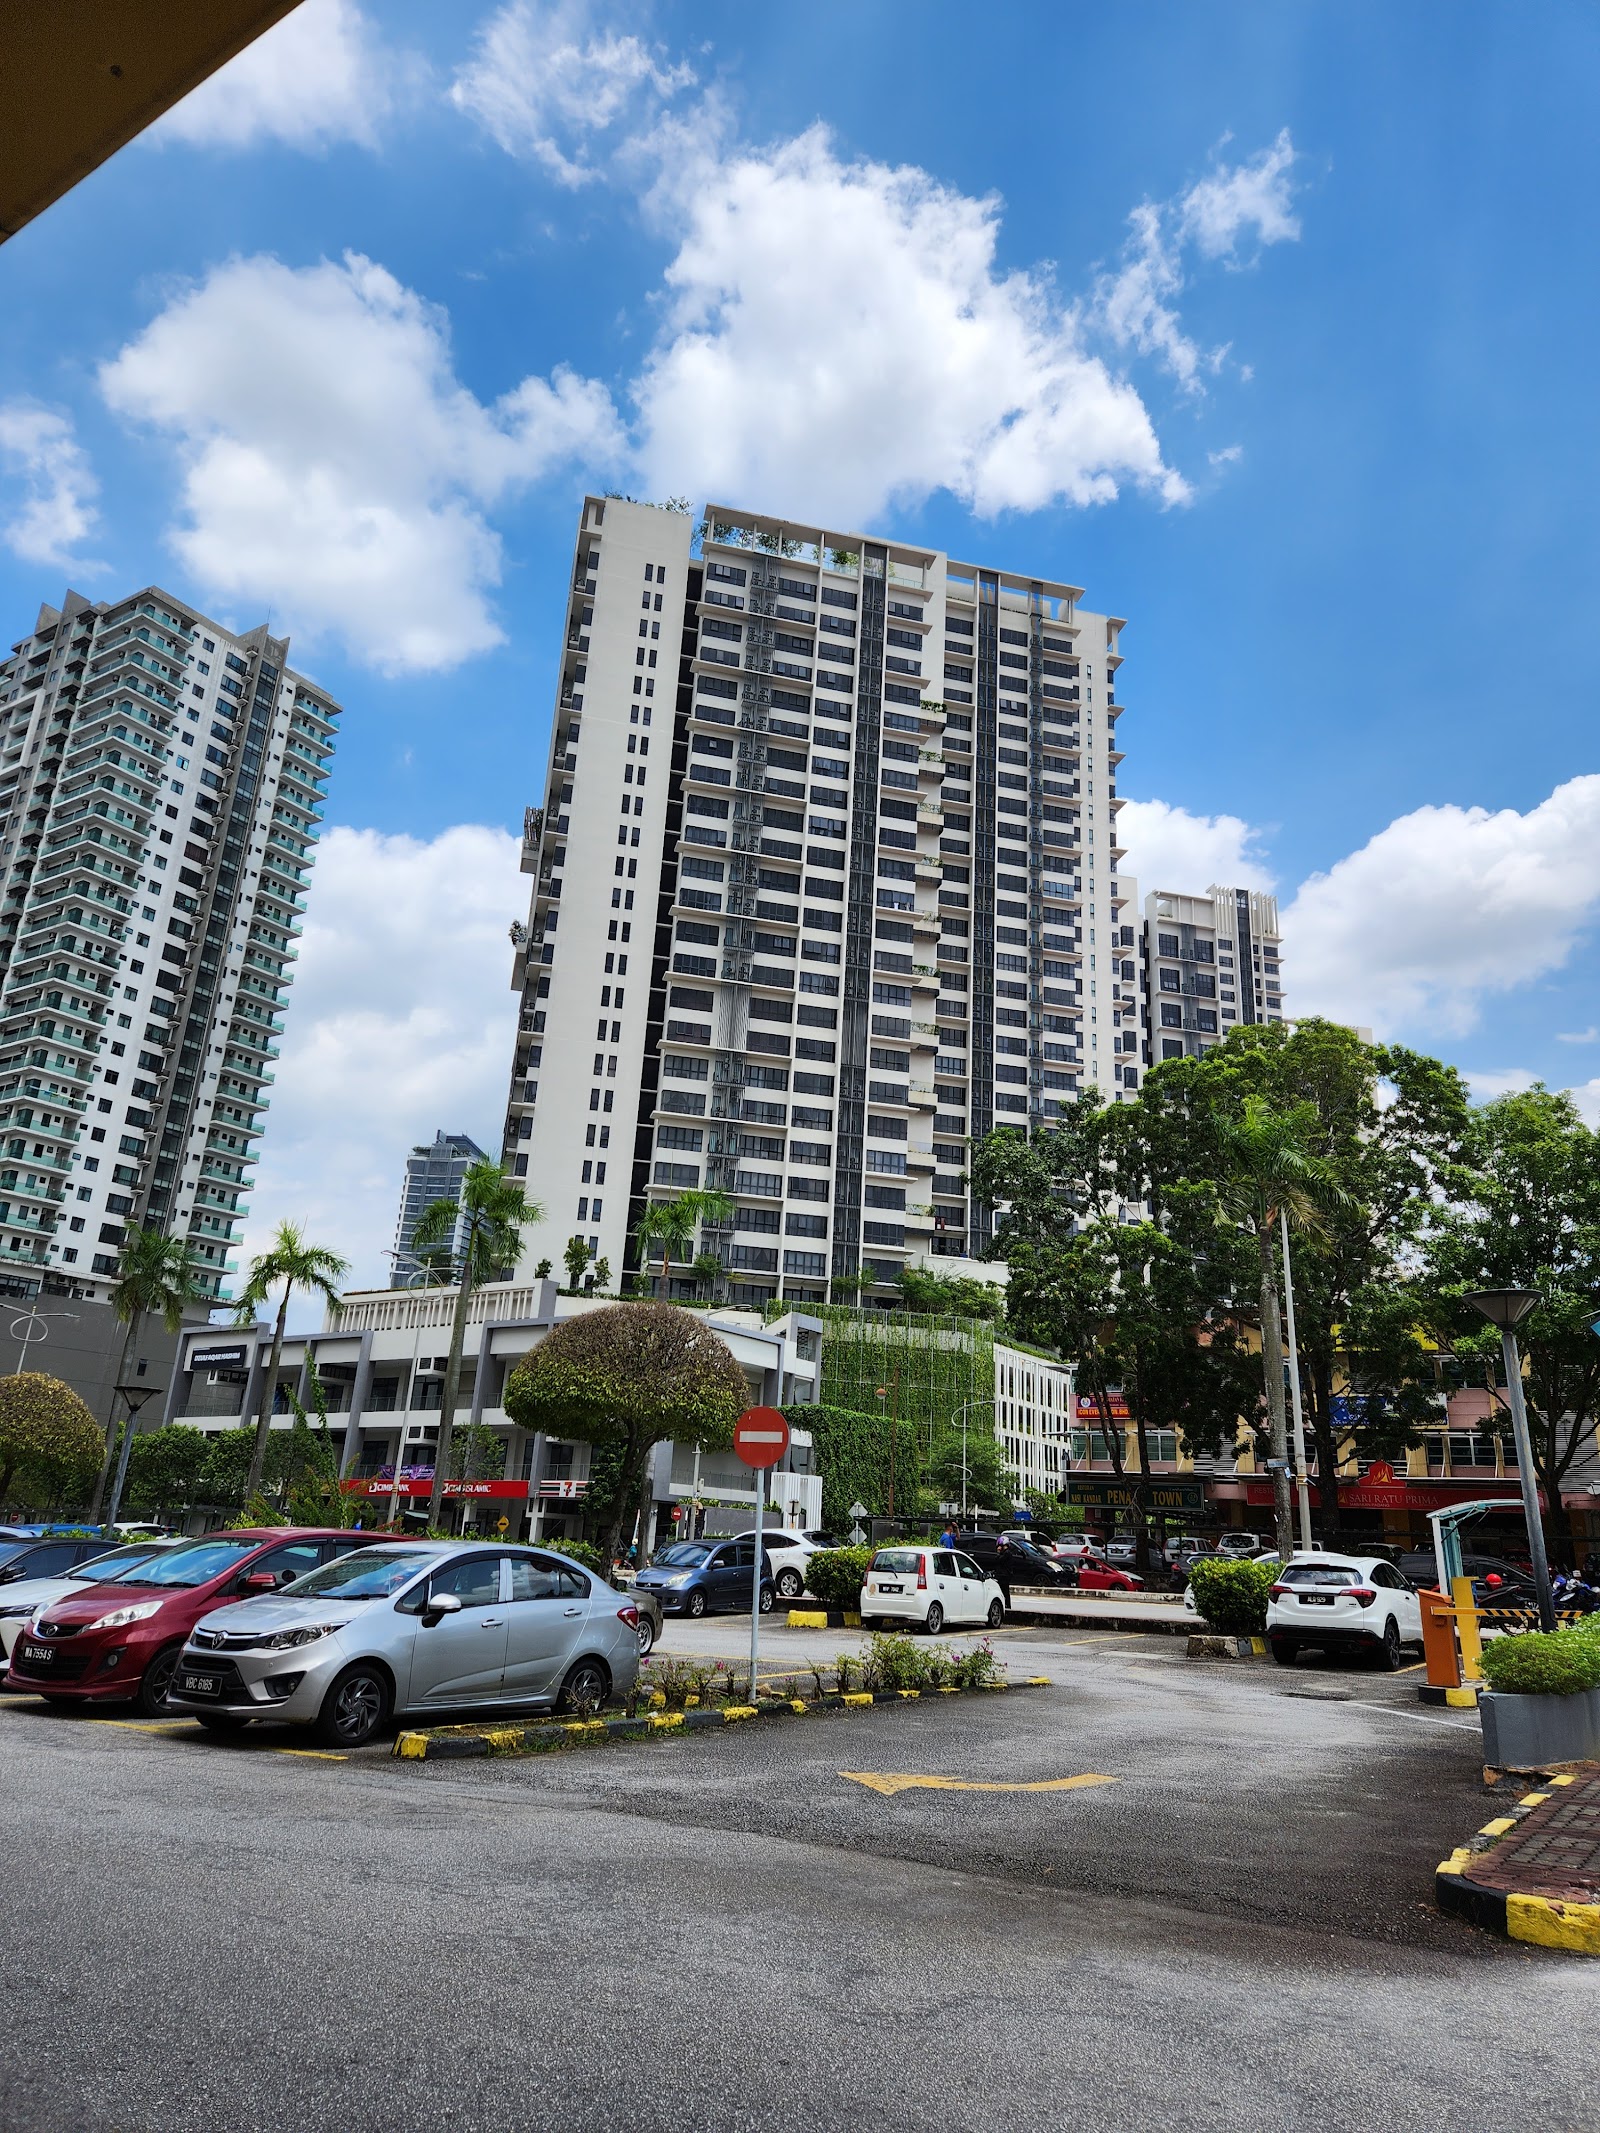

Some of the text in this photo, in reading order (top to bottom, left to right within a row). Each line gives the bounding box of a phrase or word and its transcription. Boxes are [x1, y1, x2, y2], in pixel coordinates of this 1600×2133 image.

[1071, 1494, 1082, 1503] NASI
[1107, 1490, 1132, 1505] PENA
[1152, 1491, 1183, 1506] TOWN
[1350, 1494, 1439, 1505] SARI RATU PRIMA
[47, 1650, 52, 1660] S
